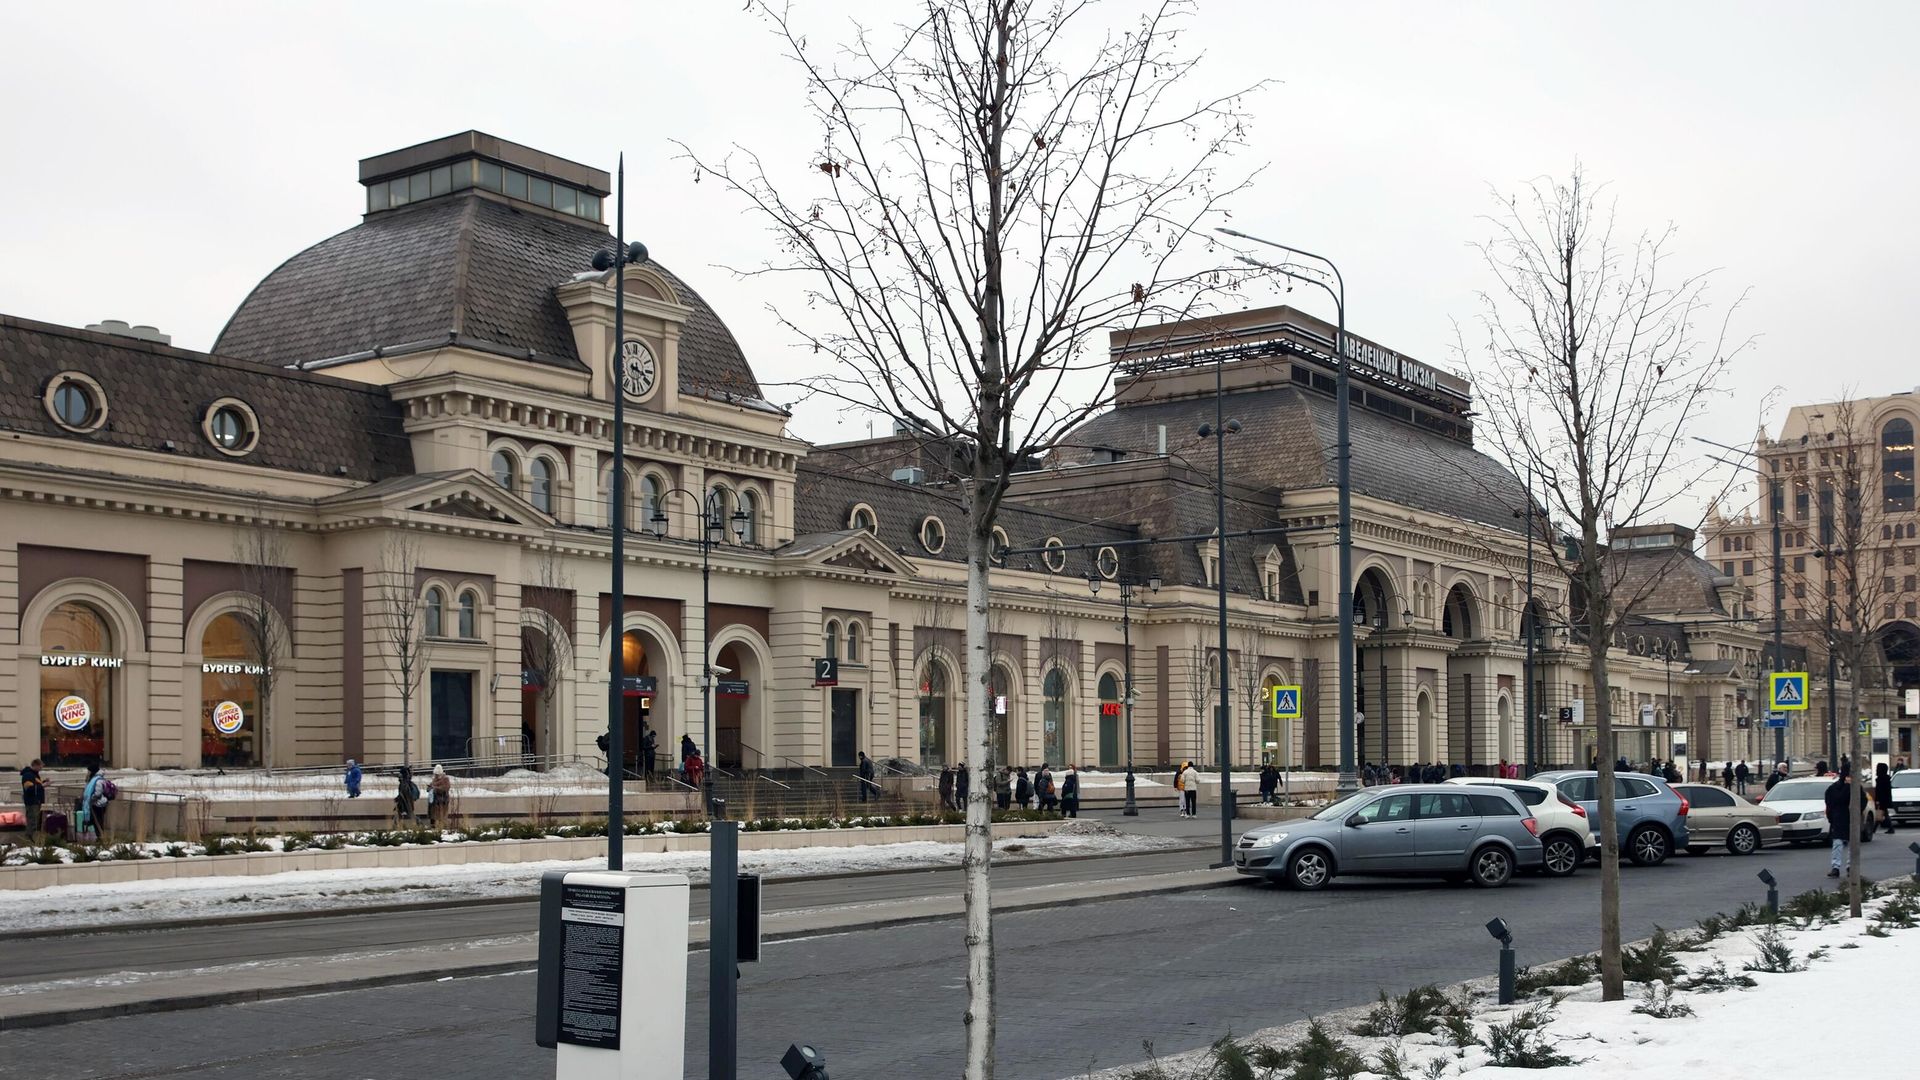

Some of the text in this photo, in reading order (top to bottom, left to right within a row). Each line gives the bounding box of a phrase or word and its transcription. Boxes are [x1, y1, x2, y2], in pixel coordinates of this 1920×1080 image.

[1401, 360, 1436, 391] ВОКЗАЛ
[42, 656, 123, 667] БУРГЕР КИНГ
[202, 664, 242, 673] БУРГЕР
[821, 661, 831, 678] 2
[61, 703, 85, 713] BURGER
[218, 708, 239, 718] BURGER
[1103, 703, 1121, 716] KFC
[61, 709, 86, 721] KING
[218, 713, 240, 725] KING
[1563, 709, 1570, 719] 3
